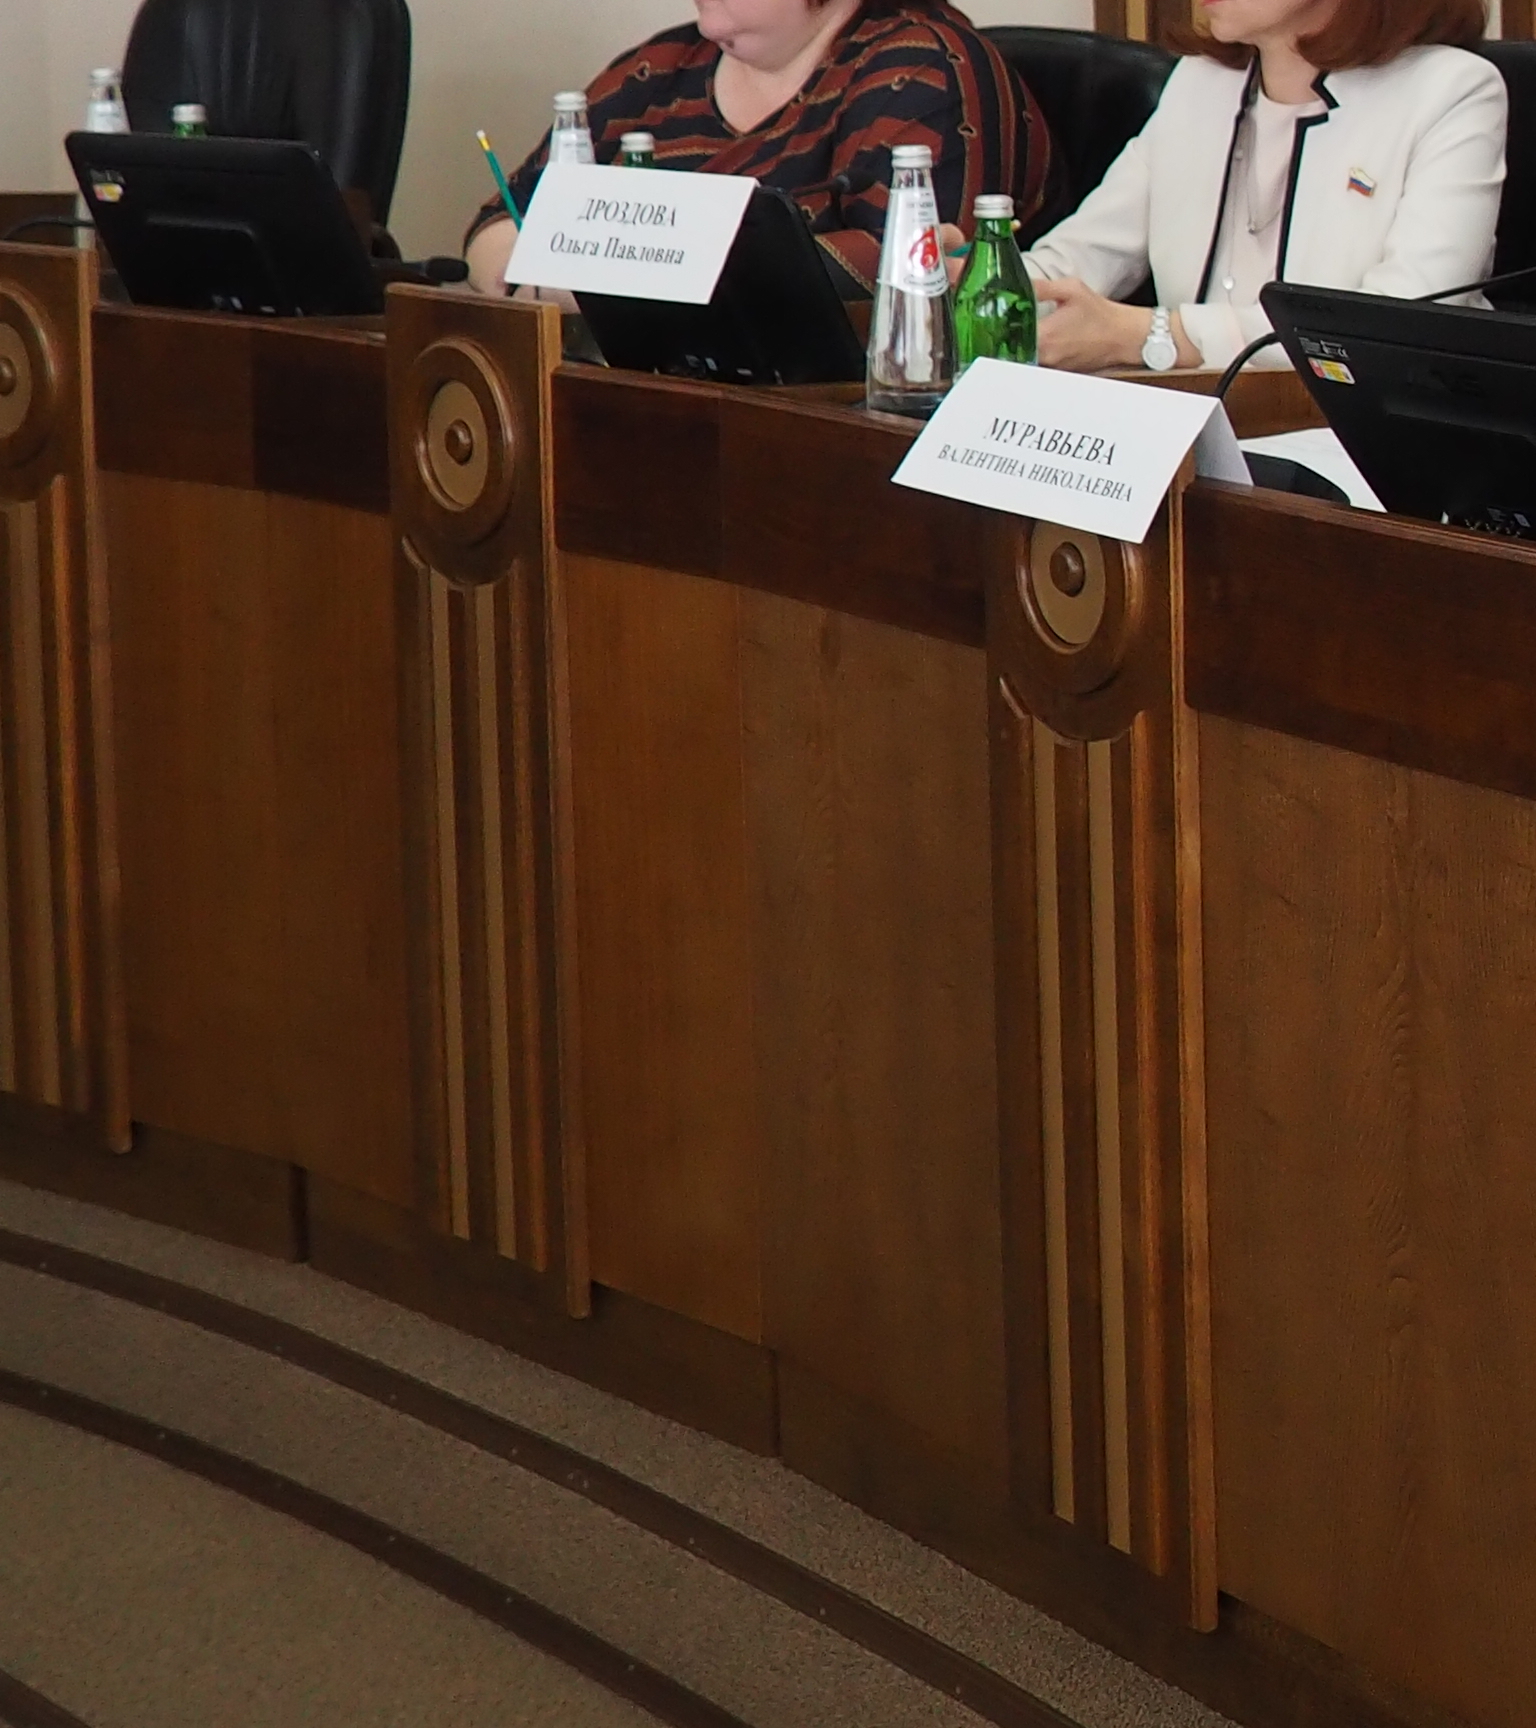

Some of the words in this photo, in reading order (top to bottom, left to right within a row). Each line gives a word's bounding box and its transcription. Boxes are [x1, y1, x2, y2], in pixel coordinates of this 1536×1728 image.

[577, 198, 677, 227] ДРОЗДОВА
[550, 231, 600, 256] Ольга
[604, 236, 685, 265] Павловна
[983, 417, 1116, 466] МУРАВЬЕВА
[937, 443, 1026, 478] ВАЛЕНТИНА
[1027, 463, 1133, 502] НИКОЛАЕВНА
